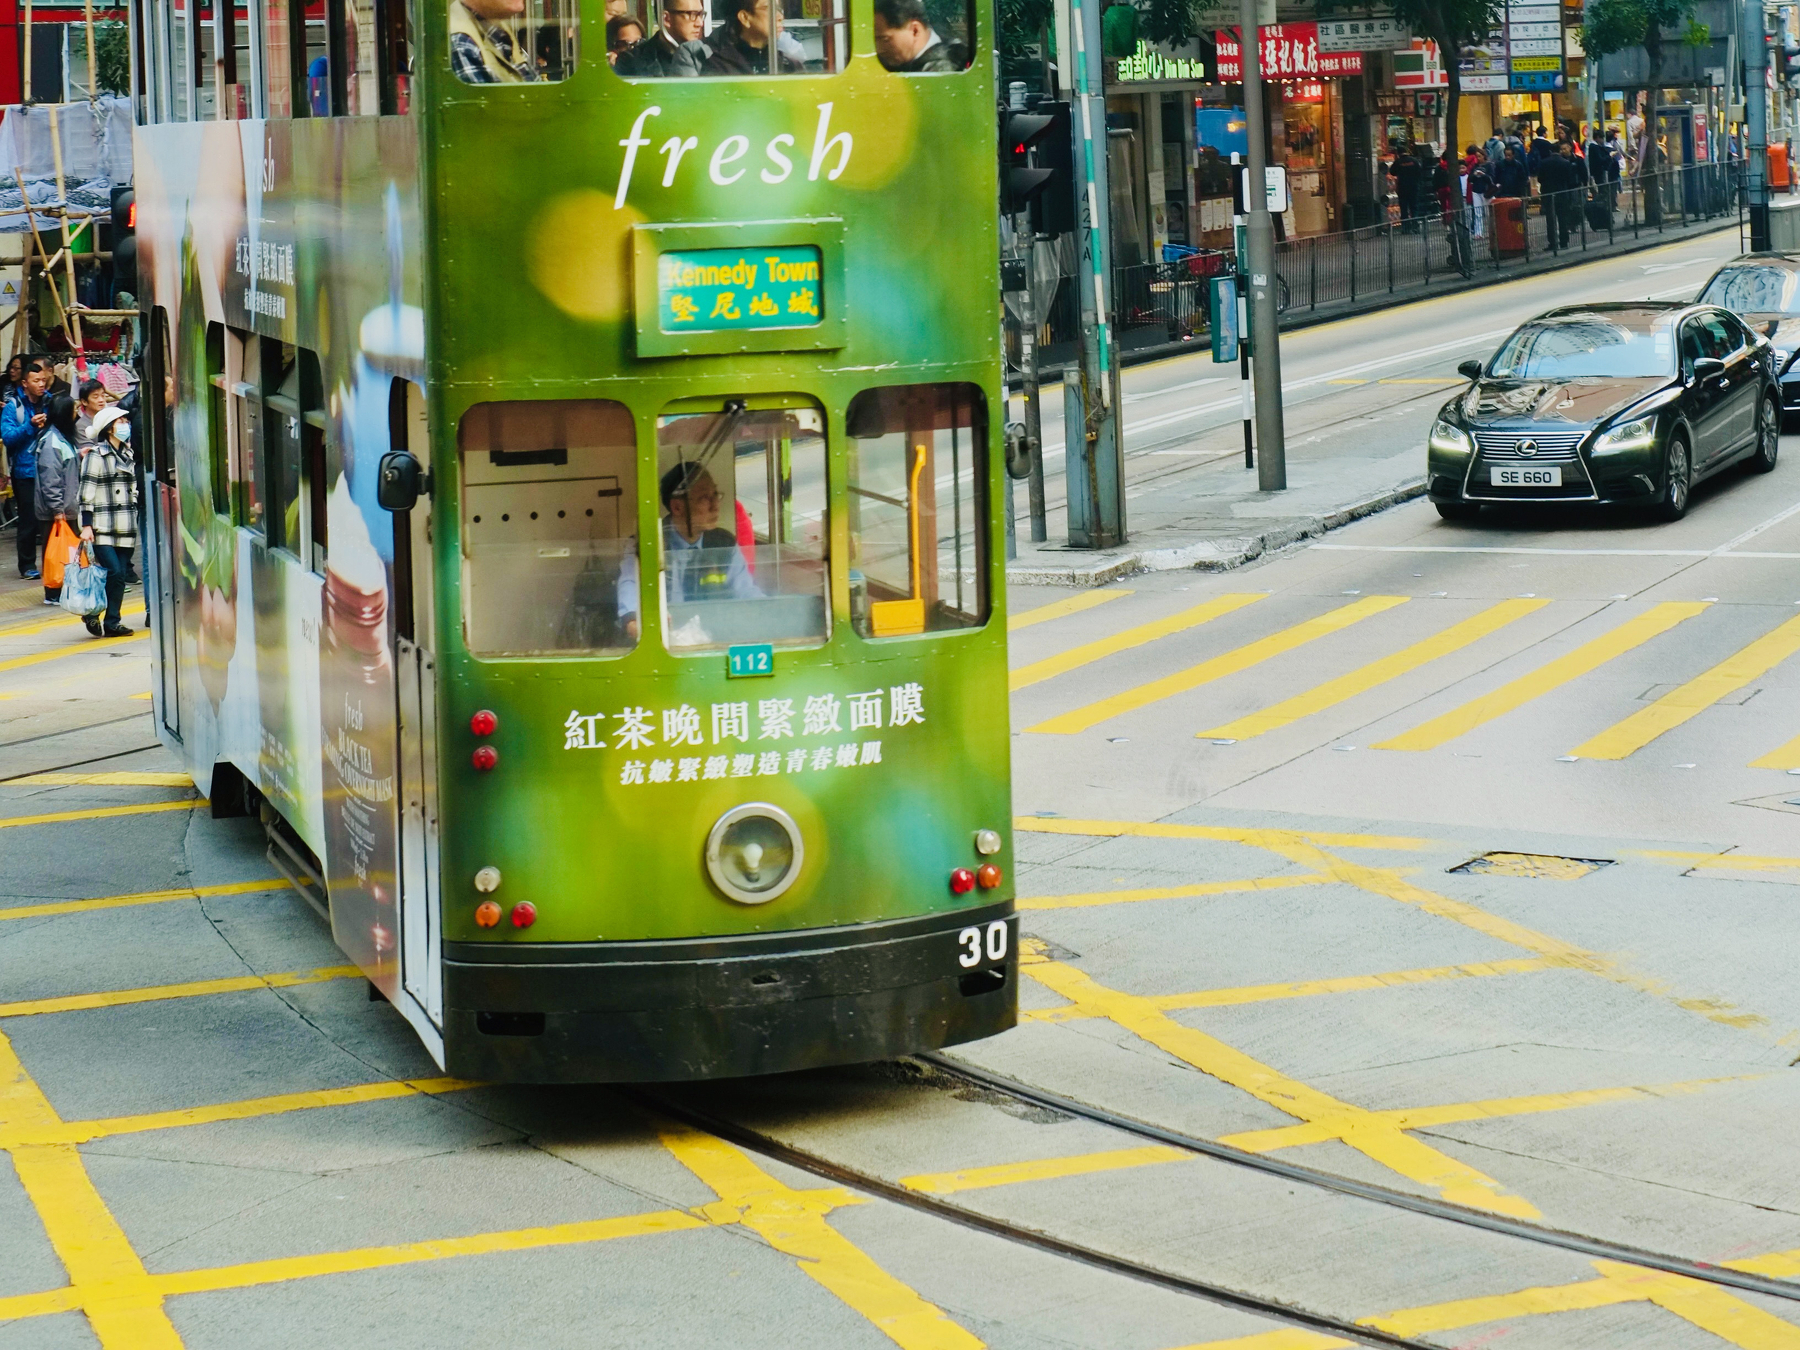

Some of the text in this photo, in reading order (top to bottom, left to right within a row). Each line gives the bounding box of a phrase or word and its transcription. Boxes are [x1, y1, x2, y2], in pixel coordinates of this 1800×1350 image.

[1319, 22, 1405, 36] 社區醫療中心
[1164, 57, 1178, 79] Dim
[1178, 57, 1190, 79] Dim
[614, 101, 853, 210] fresh
[667, 256, 819, 289] Kennedy Town
[670, 288, 819, 323] 堅尼地城
[1501, 471, 1552, 483] SE 660
[731, 652, 769, 671] 112
[344, 692, 363, 731] fresh
[563, 682, 926, 750] 紅茶晚間緊緻面膜
[338, 727, 359, 768] BLACK
[359, 745, 372, 775] TEA
[344, 761, 375, 802] OVERNIGHT
[375, 775, 394, 802] MASK
[958, 920, 1008, 968] 30
